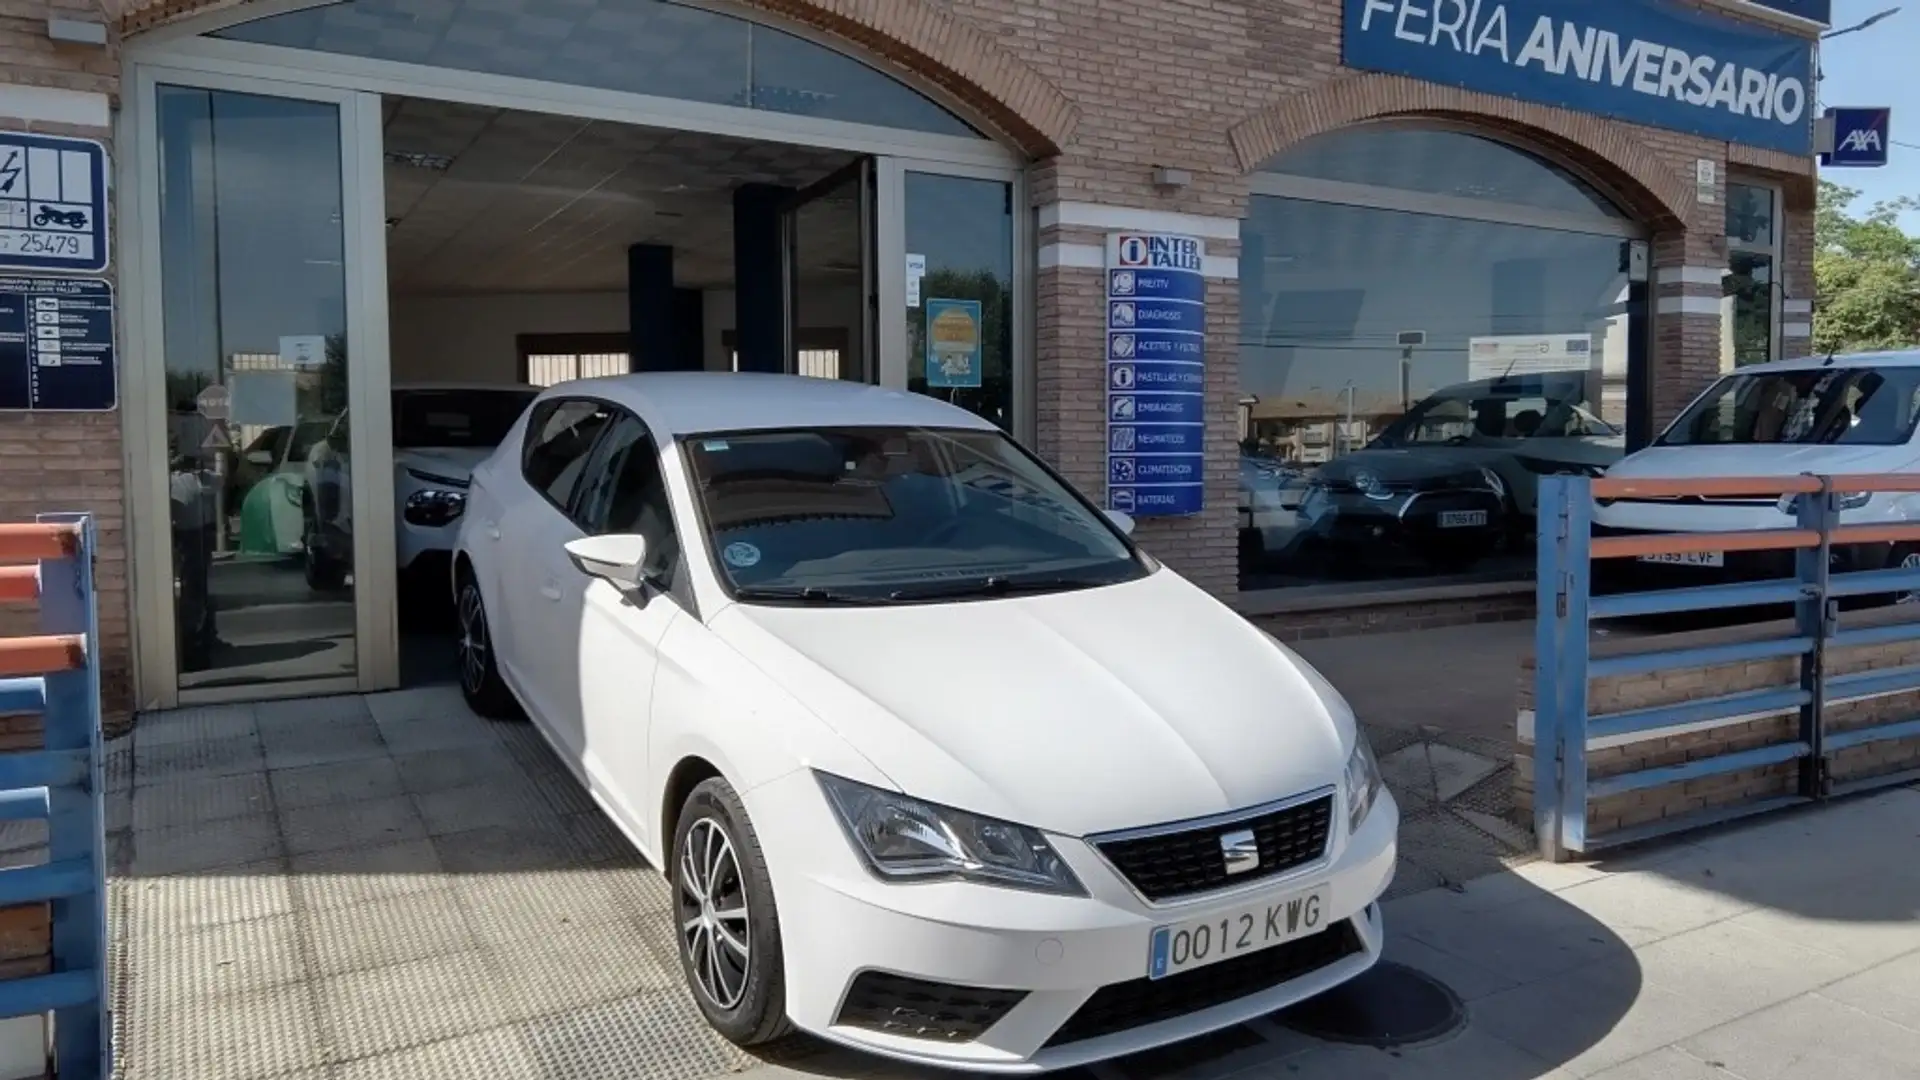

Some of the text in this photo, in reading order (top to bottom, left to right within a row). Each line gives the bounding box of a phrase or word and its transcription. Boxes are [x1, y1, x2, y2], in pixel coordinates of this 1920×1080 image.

[1361, 0, 1805, 125] FERIA ANIVERSARIO
[1837, 129, 1882, 152] AXA
[20, 232, 79, 254] 25479
[1149, 236, 1198, 257] INTER
[1152, 251, 1201, 271] TALLER
[1138, 310, 1182, 321] DIAGNOSIS
[1138, 341, 1172, 351] ACEITES
[1137, 372, 1177, 382] PASTILLAS
[1172, 913, 1254, 965] 0012
[1265, 895, 1320, 940] KWG
